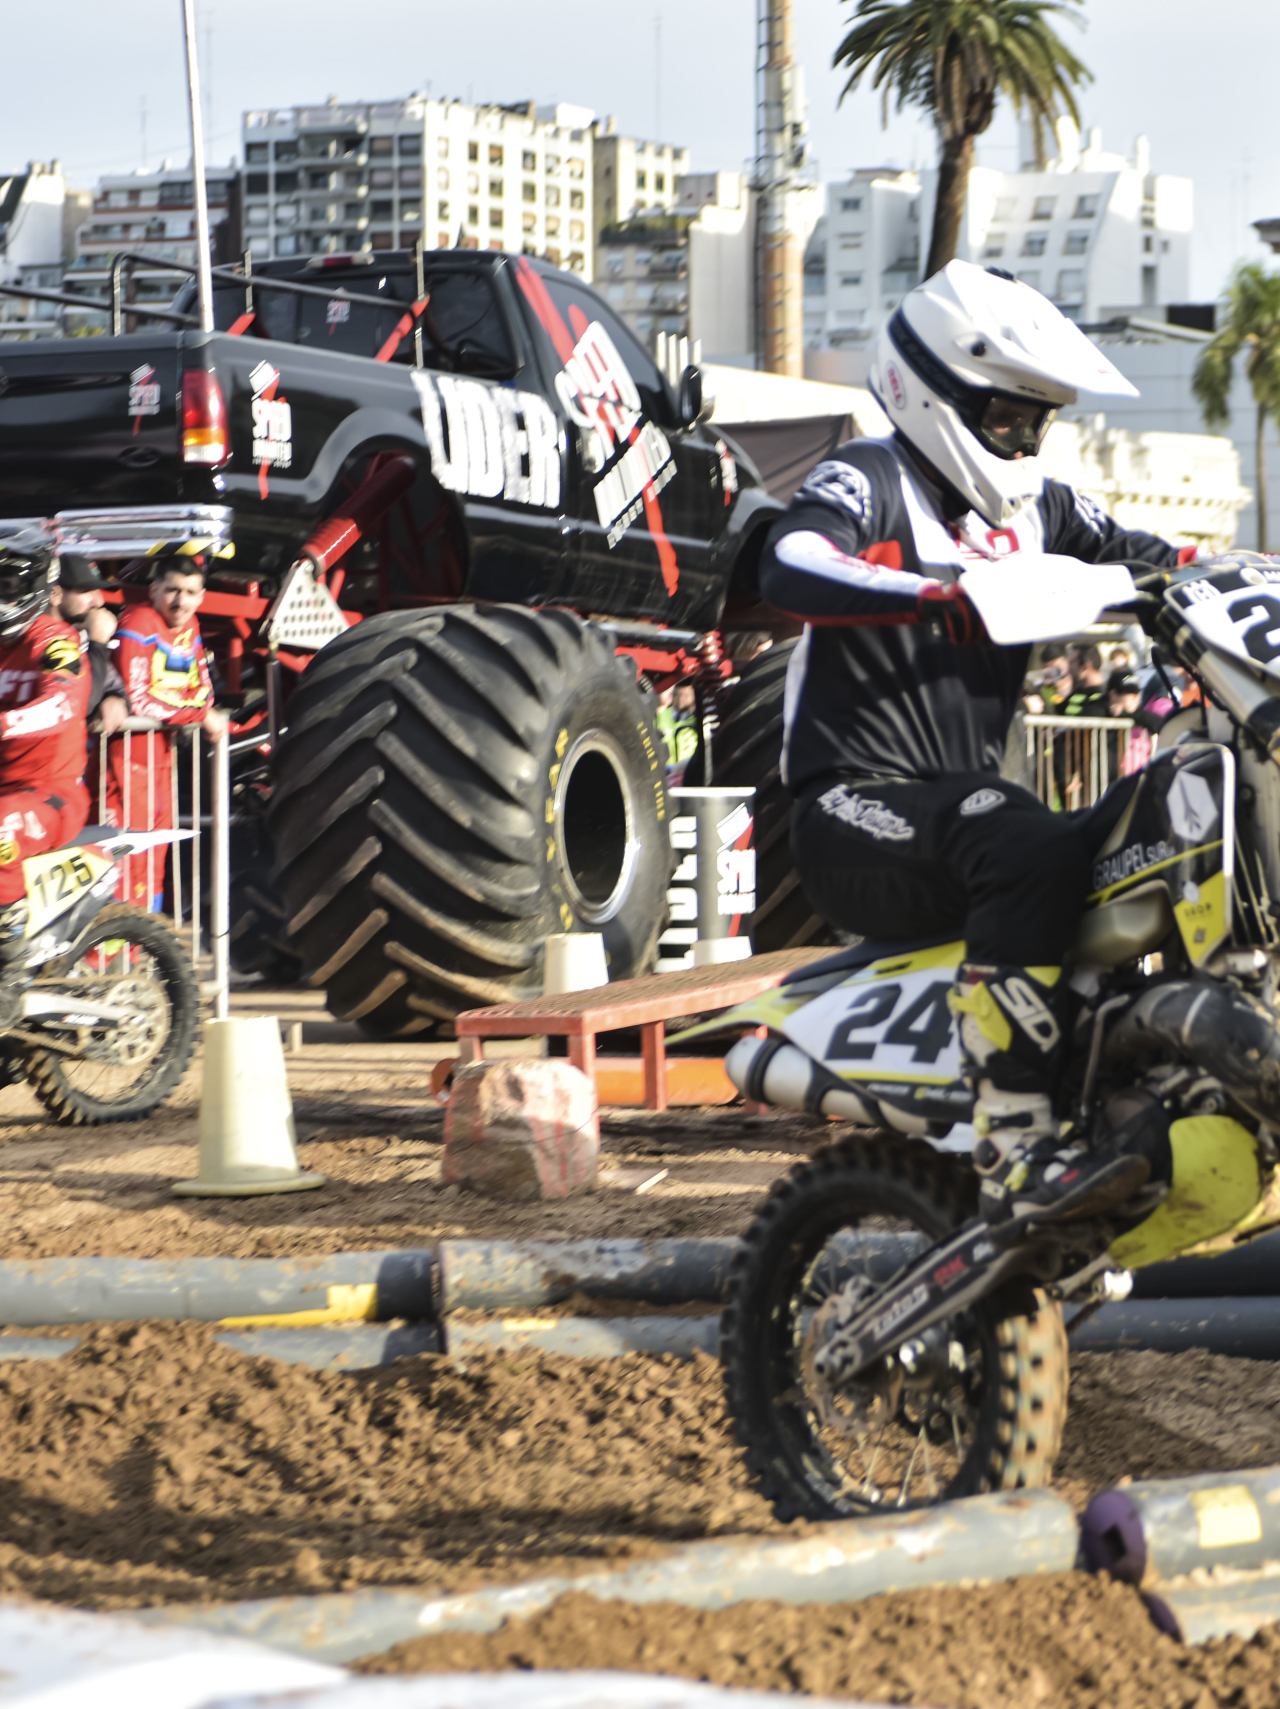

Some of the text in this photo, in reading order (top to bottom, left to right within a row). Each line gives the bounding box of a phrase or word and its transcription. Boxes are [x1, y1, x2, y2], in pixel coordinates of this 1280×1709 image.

[888, 368, 902, 403] BELL
[34, 854, 93, 907] 125
[1092, 842, 1148, 890] GRAUPEL
[824, 978, 957, 1064] 24
